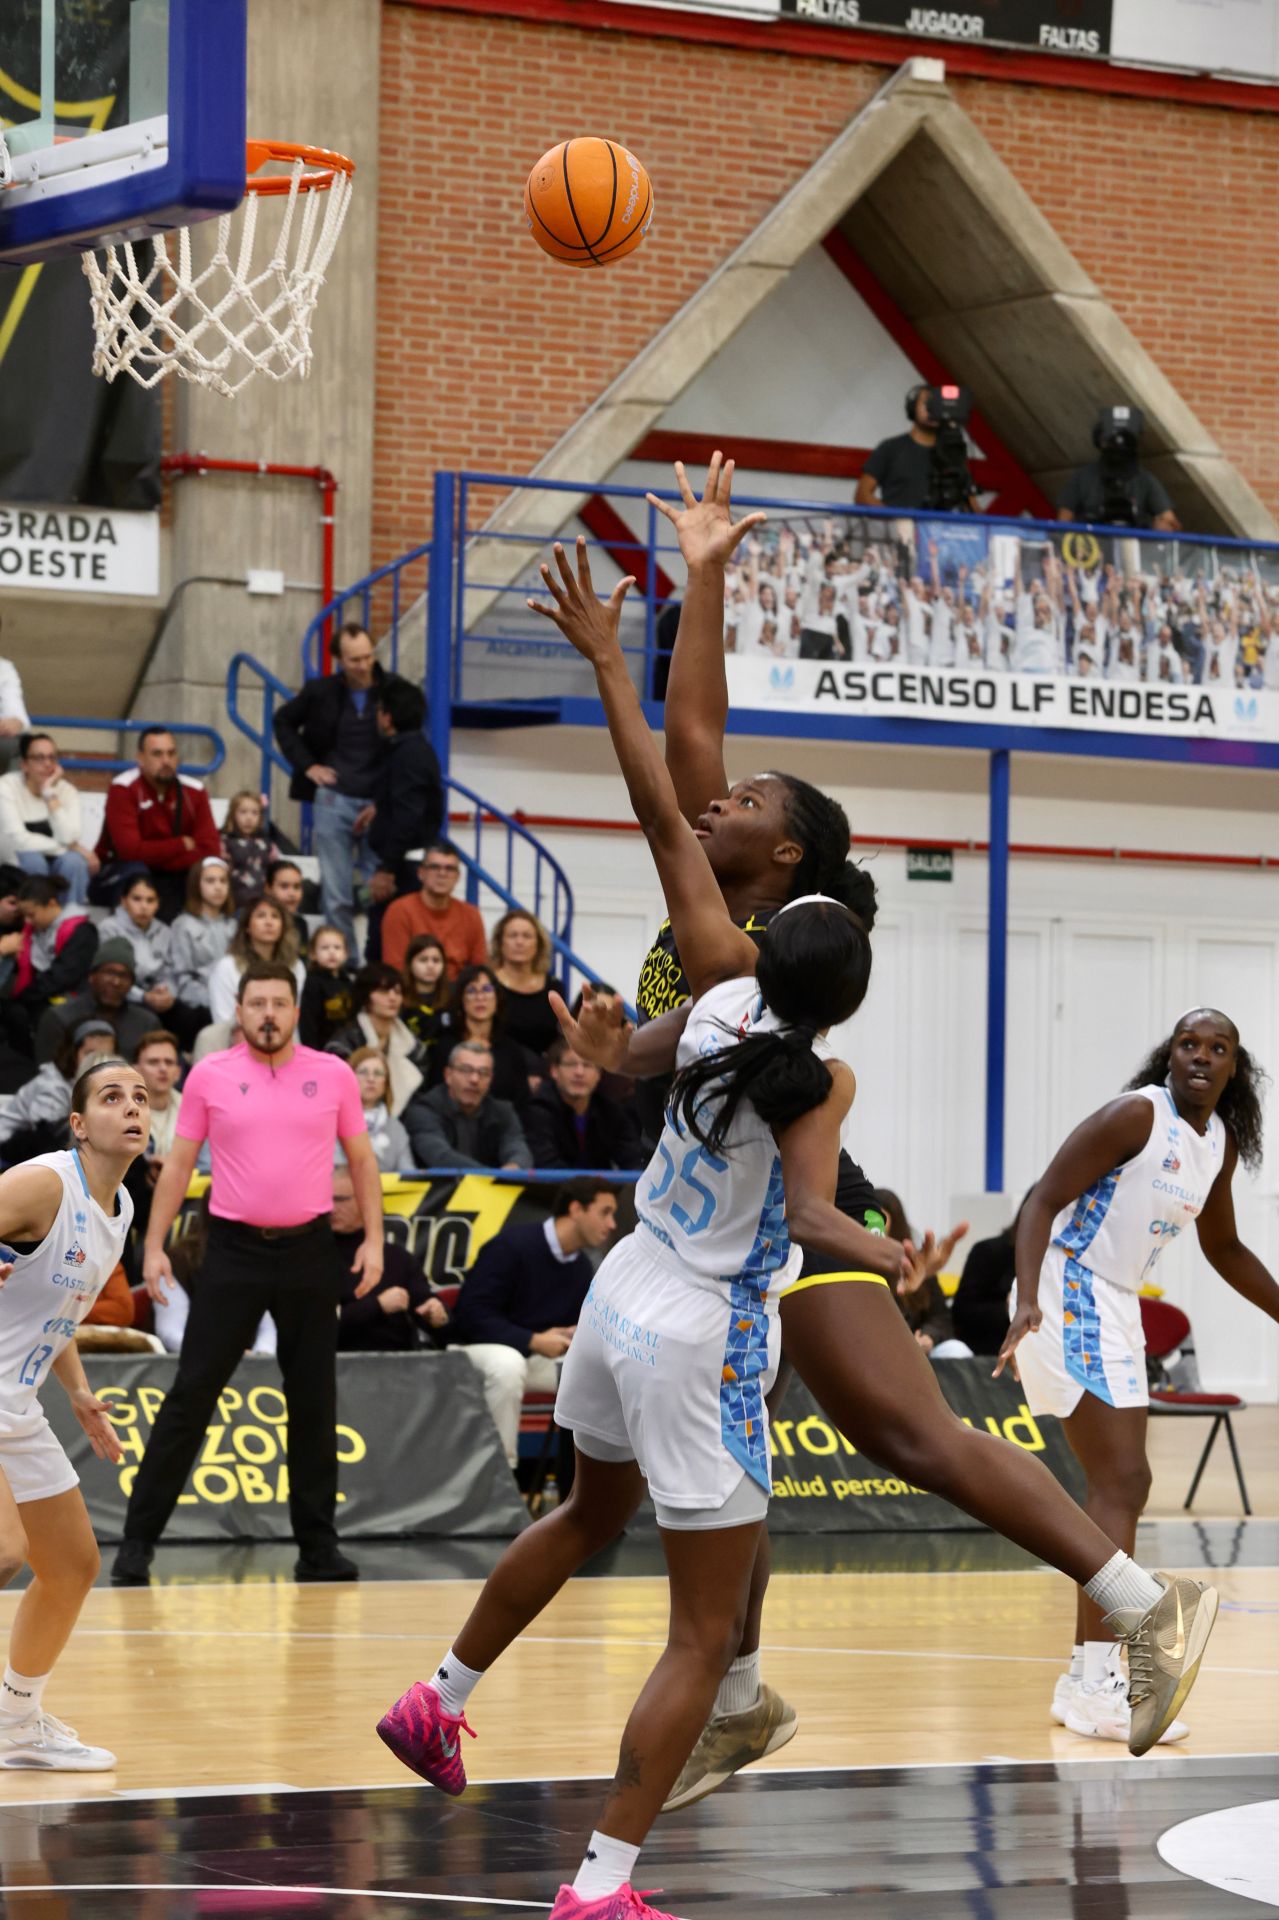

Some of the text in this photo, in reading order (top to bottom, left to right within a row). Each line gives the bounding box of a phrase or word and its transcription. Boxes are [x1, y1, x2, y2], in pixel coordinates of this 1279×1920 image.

[796, 0, 1100, 50] FALTAS JUGADOR FALTAS
[0, 546, 106, 581] OESTE
[814, 669, 1216, 725] ASCENSO LF ENDESA
[907, 853, 952, 872] SALIDA
[96, 1386, 289, 1426] GRPO
